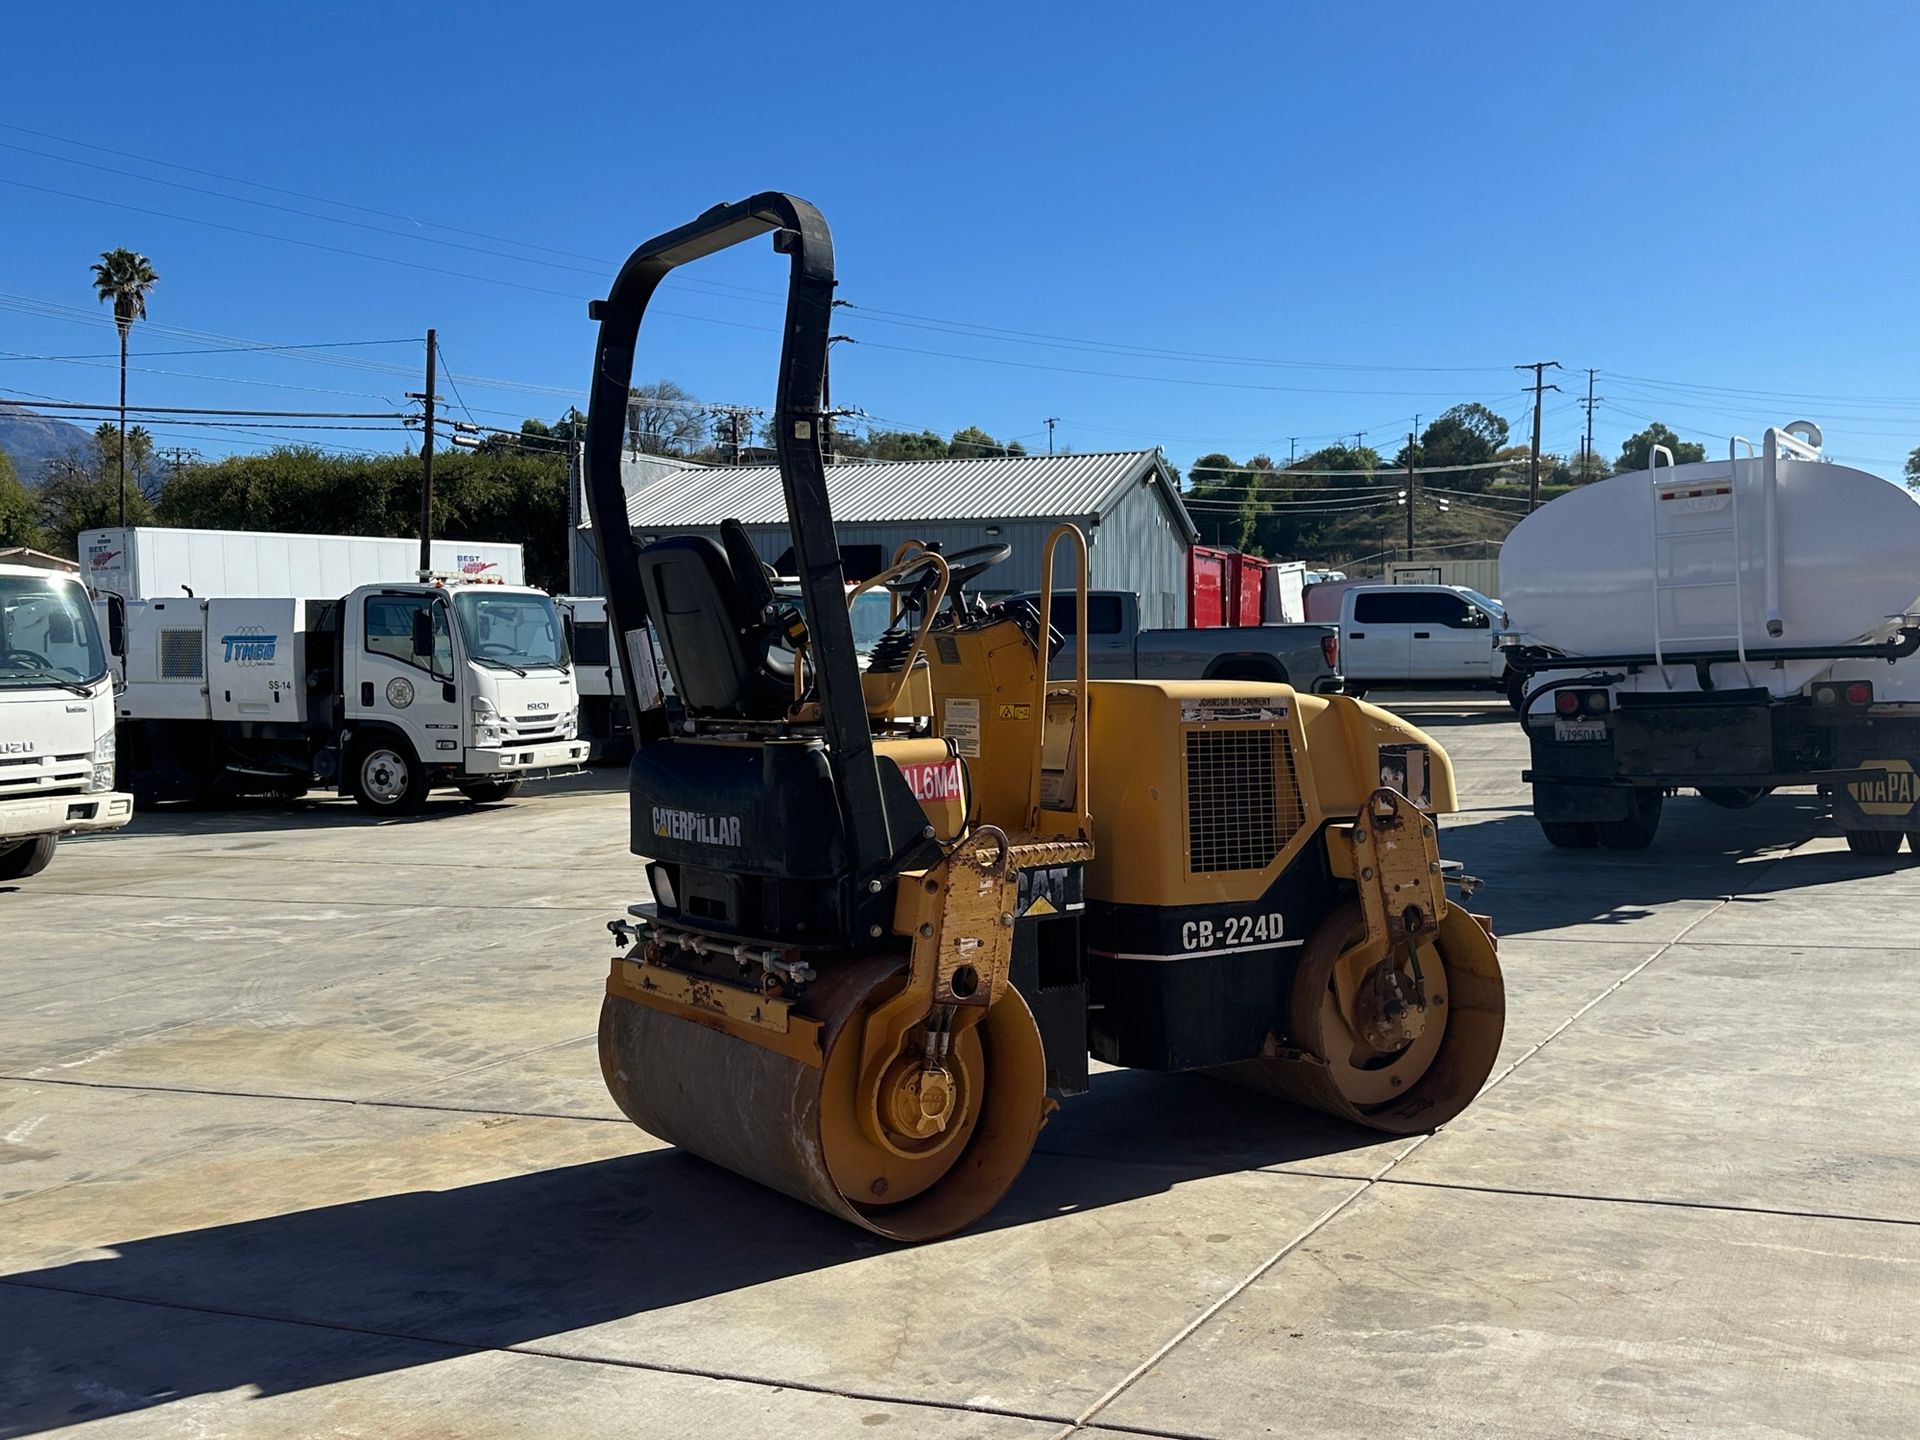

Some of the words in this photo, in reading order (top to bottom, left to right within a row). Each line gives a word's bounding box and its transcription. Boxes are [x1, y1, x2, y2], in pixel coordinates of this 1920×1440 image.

[268, 680, 291, 690] SS-14
[1859, 773, 1912, 802] NAPA
[652, 806, 741, 847] CATERPILLAR
[1183, 913, 1284, 950] CB-224D
